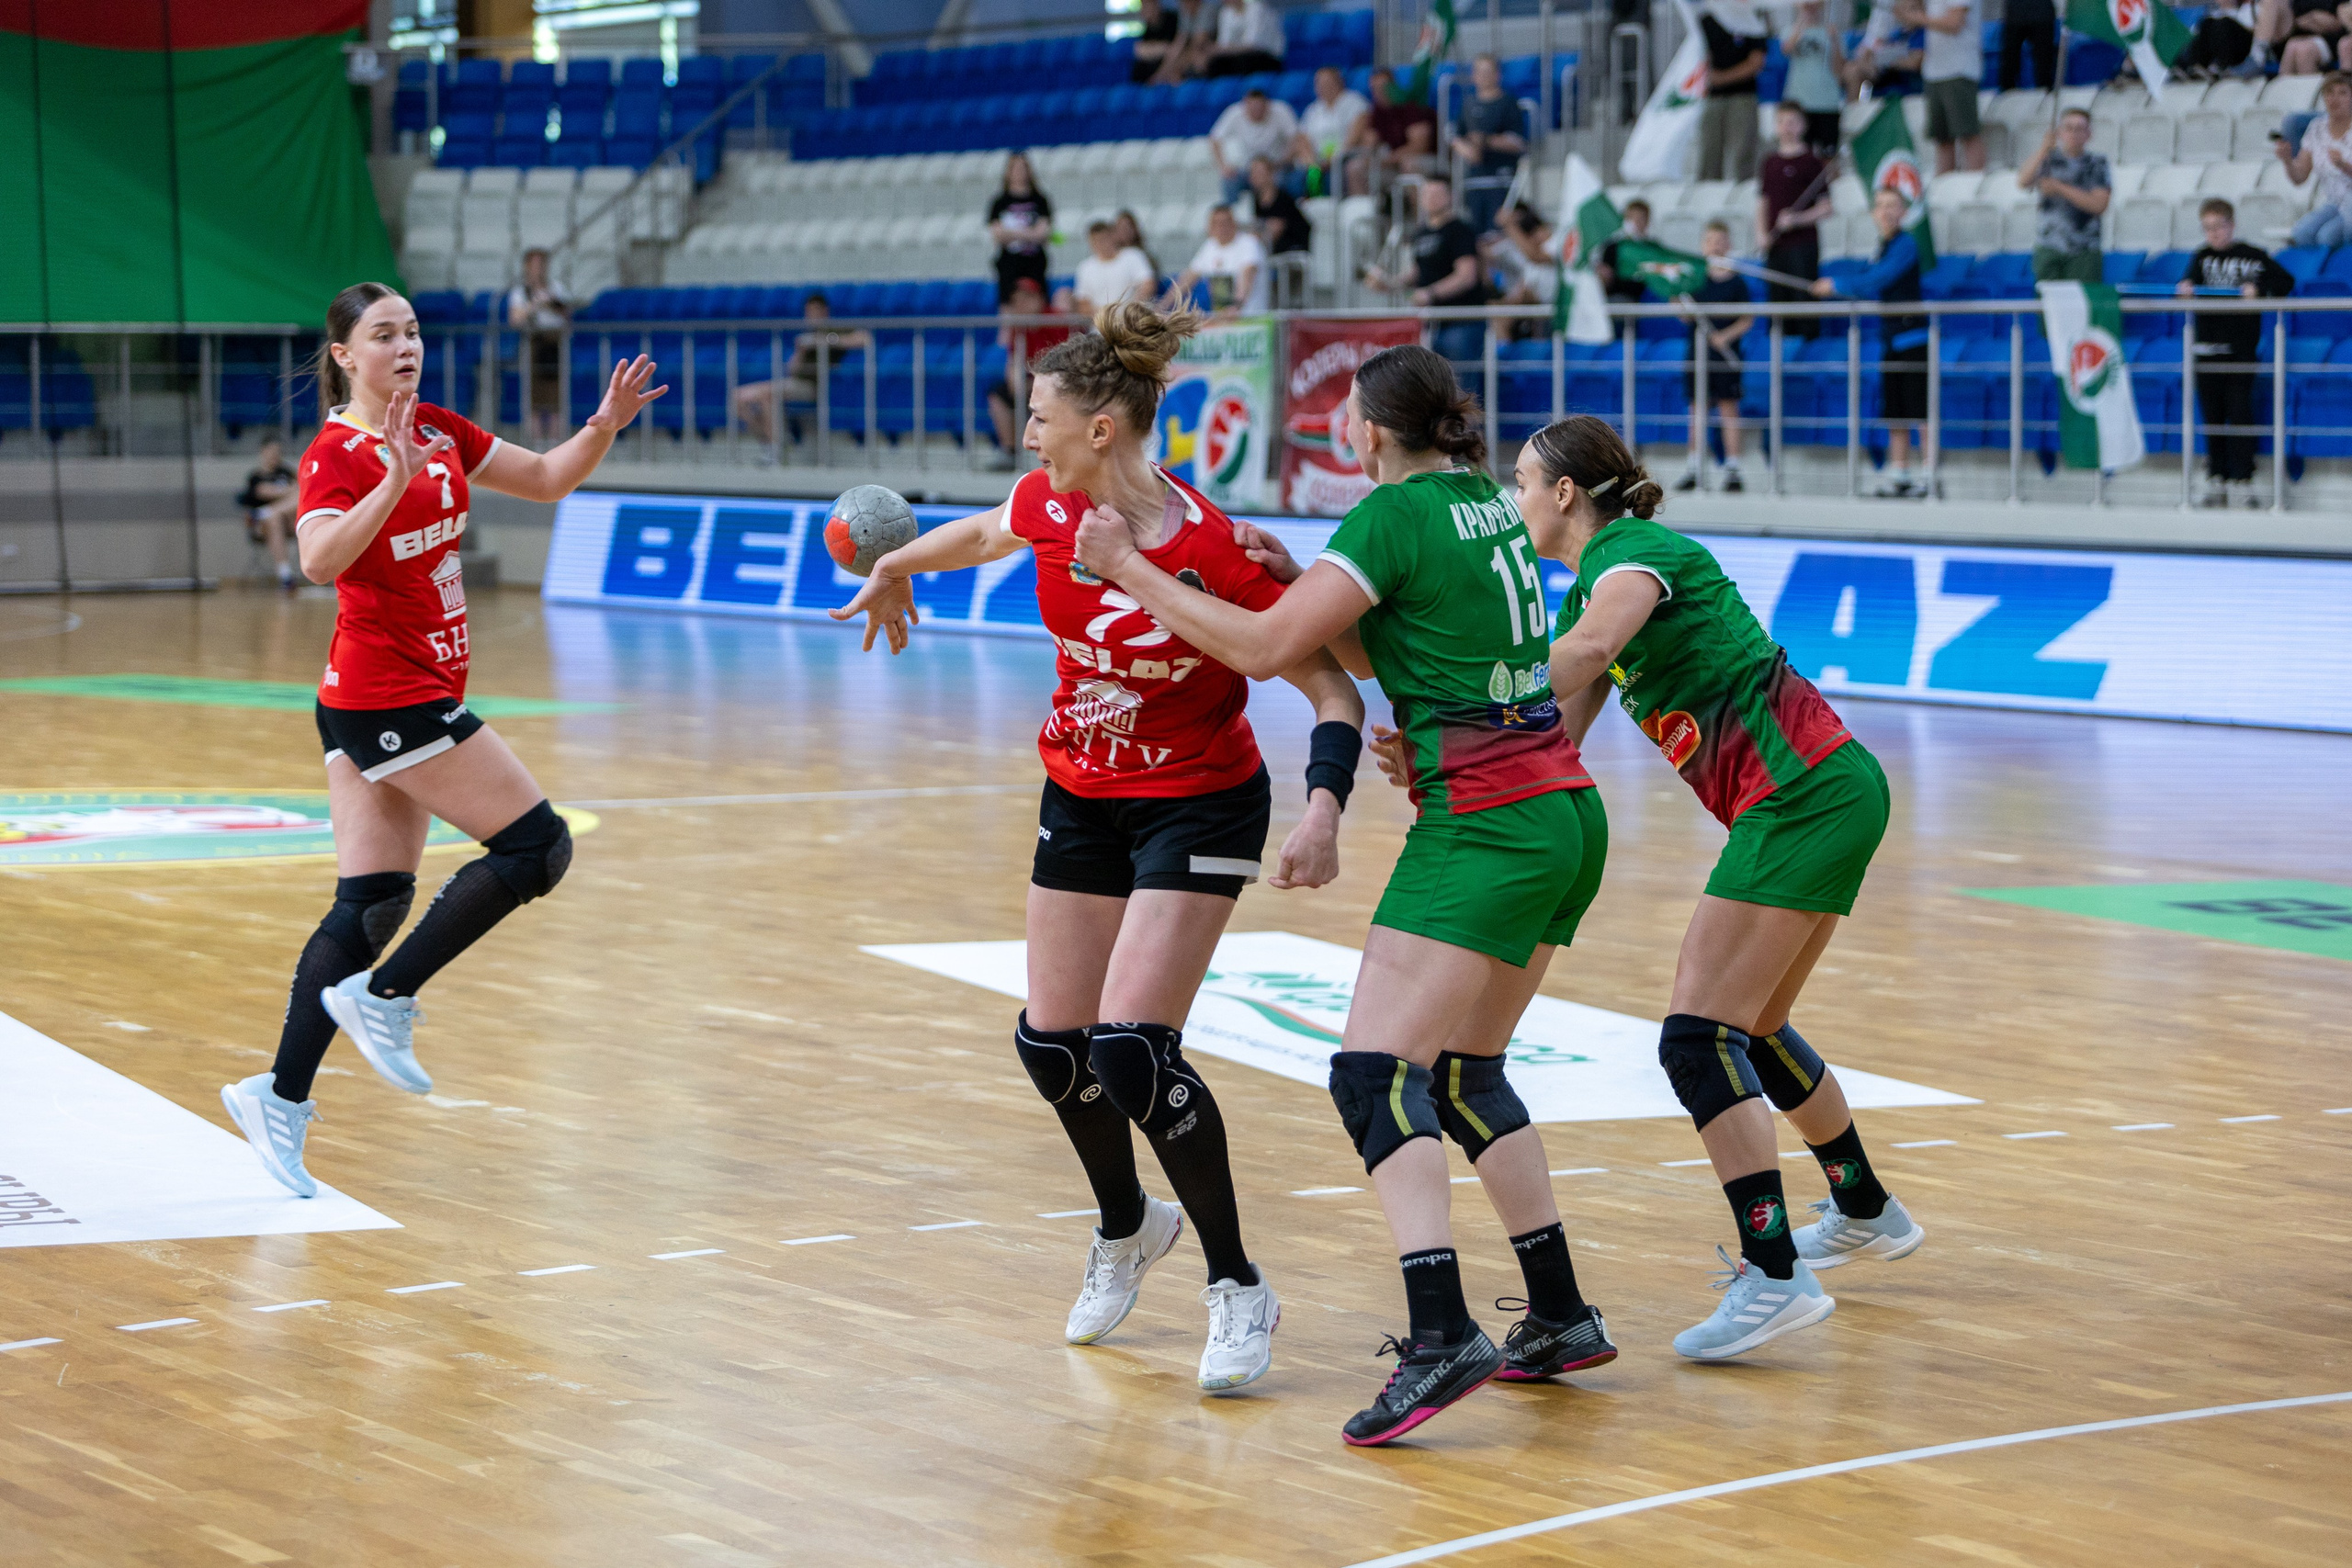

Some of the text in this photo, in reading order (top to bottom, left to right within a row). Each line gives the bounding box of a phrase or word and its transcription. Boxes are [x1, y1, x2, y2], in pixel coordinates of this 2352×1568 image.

[342, 432, 368, 452] Kemp
[426, 462, 454, 510] 7
[1490, 534, 1545, 646] 15
